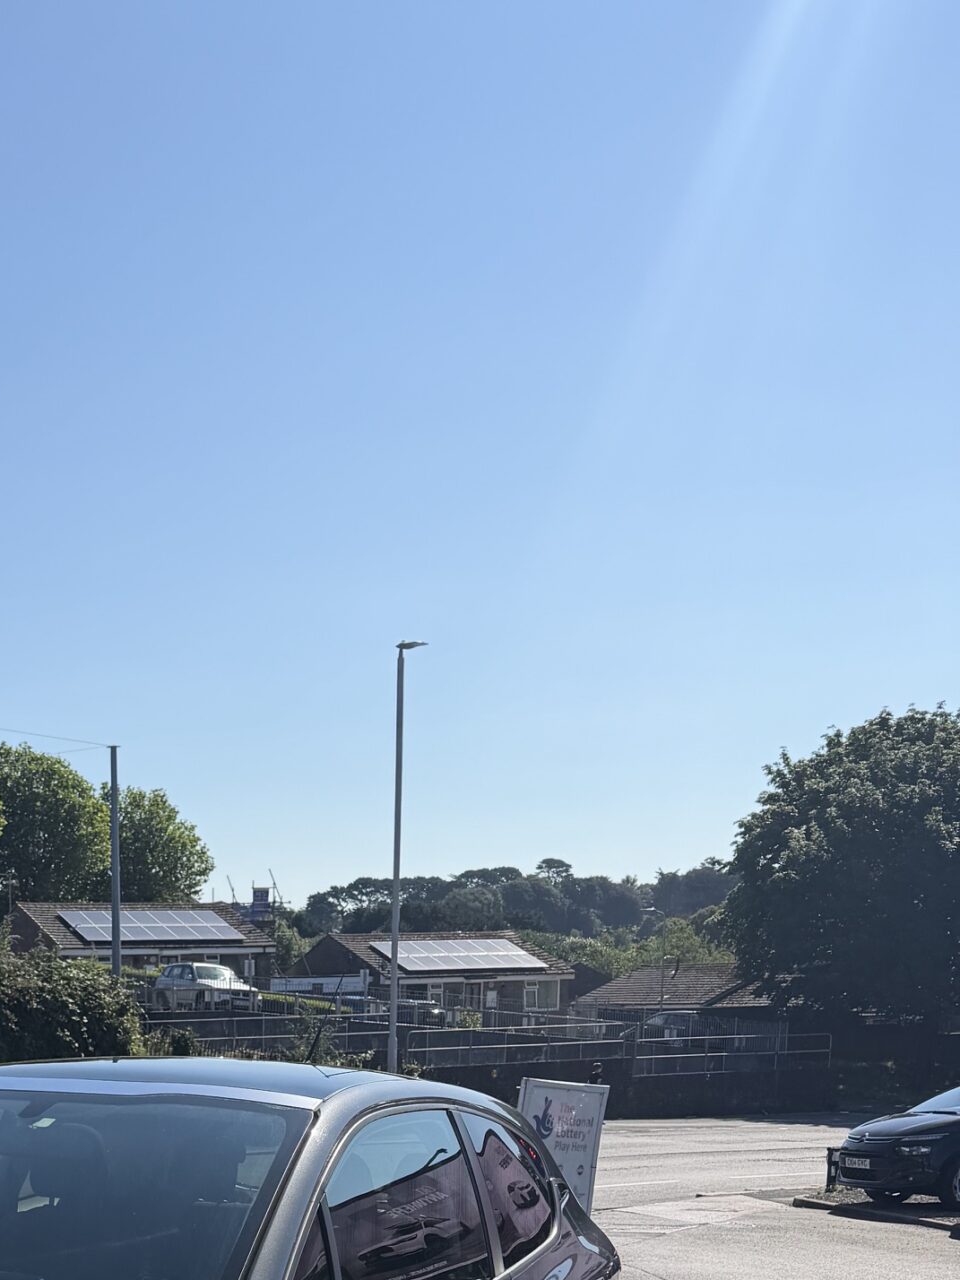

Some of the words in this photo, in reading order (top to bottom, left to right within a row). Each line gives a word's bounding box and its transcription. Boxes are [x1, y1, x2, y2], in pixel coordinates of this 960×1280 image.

[560, 1103, 575, 1113] The
[558, 1115, 594, 1128] National
[554, 1140, 570, 1154] Play
[571, 1142, 587, 1152] Here
